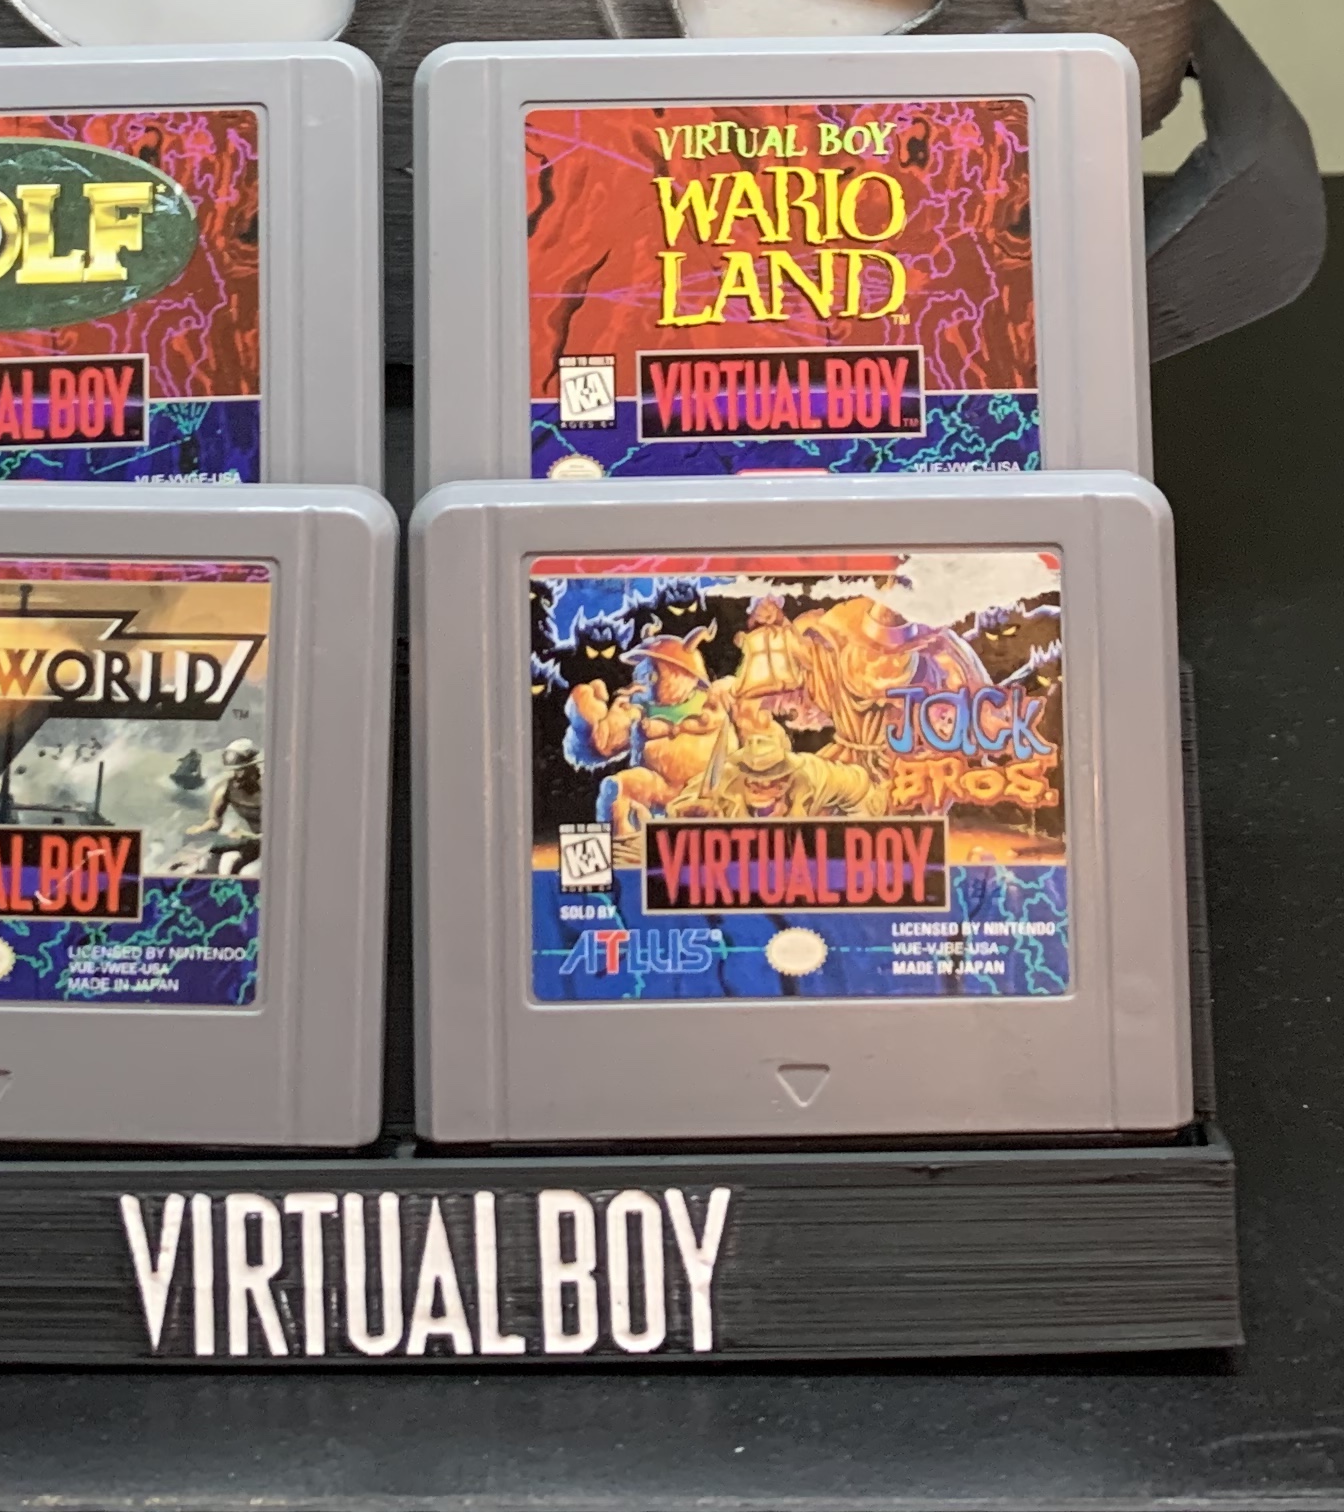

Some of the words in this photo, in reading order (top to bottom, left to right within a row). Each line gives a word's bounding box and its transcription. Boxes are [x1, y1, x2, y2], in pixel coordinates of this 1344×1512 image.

[655, 121, 807, 161] VIRTUAL
[817, 121, 897, 156] BOY
[651, 166, 906, 247] WARIO
[656, 248, 906, 327] LAND
[49, 366, 135, 440] BOY
[649, 359, 823, 433] VIRTUAL
[825, 356, 909, 429] BOY
[39, 834, 132, 913] BOY
[656, 828, 840, 906] VIRTUAL
[844, 826, 934, 904] BOY
[560, 904, 593, 921] SOLD
[596, 904, 617, 920] BY
[891, 921, 959, 937] LICENSED
[961, 921, 981, 936] BY
[983, 921, 1056, 937] NINTENDO
[67, 945, 142, 960] LICENSED
[145, 946, 165, 960] BY
[168, 946, 247, 961] NINTENDO
[559, 928, 713, 975] ATLUS
[892, 960, 934, 976] MADE
[936, 960, 951, 975] IN
[955, 959, 1005, 975] JAPAN
[68, 976, 110, 991] MADE
[113, 977, 130, 991] IN
[133, 977, 180, 992] JAPAN
[119, 1190, 526, 1356] VIRTUAL
[537, 1188, 731, 1354] BOY
